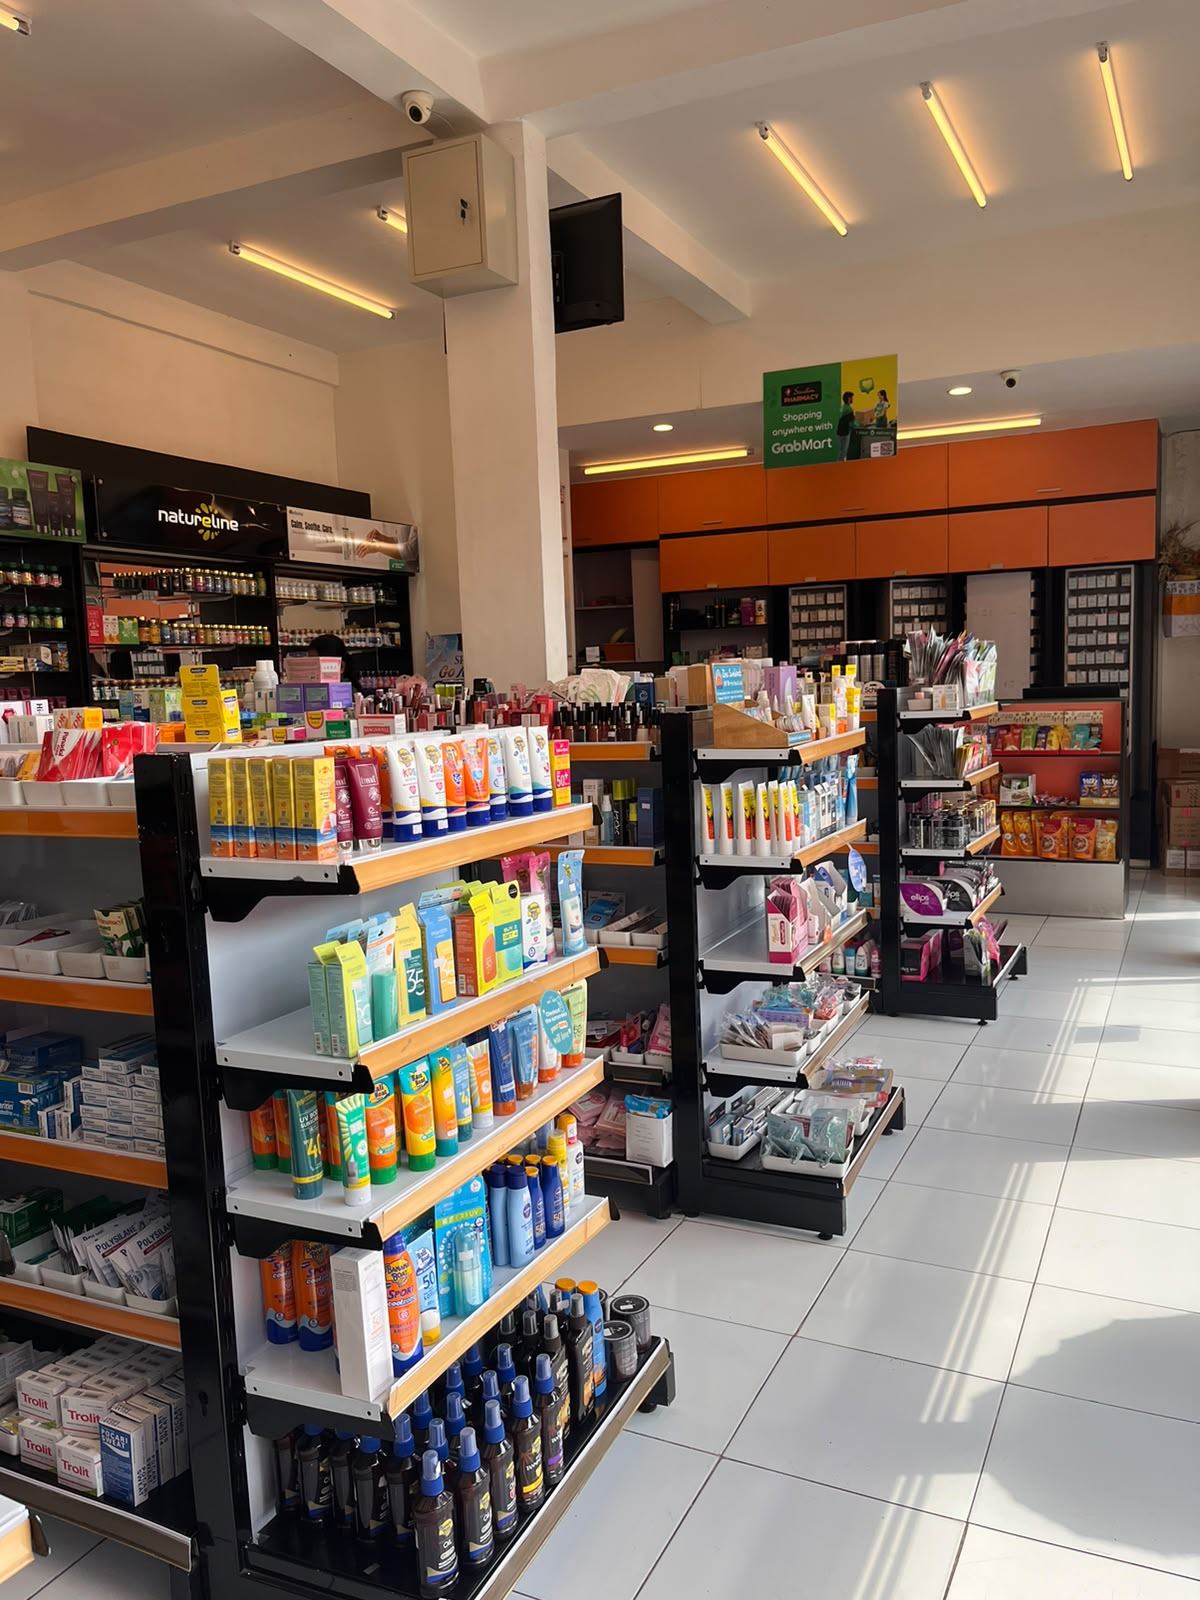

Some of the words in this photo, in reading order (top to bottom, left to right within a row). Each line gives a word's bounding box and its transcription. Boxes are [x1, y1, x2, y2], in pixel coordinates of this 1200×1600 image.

[783, 410, 822, 422] Shopping
[772, 426, 813, 437] anywhere
[815, 422, 833, 431] with
[771, 437, 832, 454] GrabMart
[158, 508, 239, 531] natureline
[291, 520, 303, 529] Calm.
[304, 521, 321, 532] Soothe.
[439, 665, 455, 678] Go
[556, 770, 569, 787] 50+
[911, 894, 929, 903] elips
[406, 968, 425, 996] 35
[299, 1113, 309, 1123] UV
[95, 1225, 137, 1253] POLYSILANE
[422, 1270, 436, 1289] 50
[21, 1393, 49, 1410] Trolit
[68, 1410, 101, 1424] Trolit
[101, 1428, 129, 1444] POCARI
[101, 1434, 126, 1449] SWEAT
[24, 1438, 52, 1456] Trolit
[61, 1459, 90, 1478] Trolit
